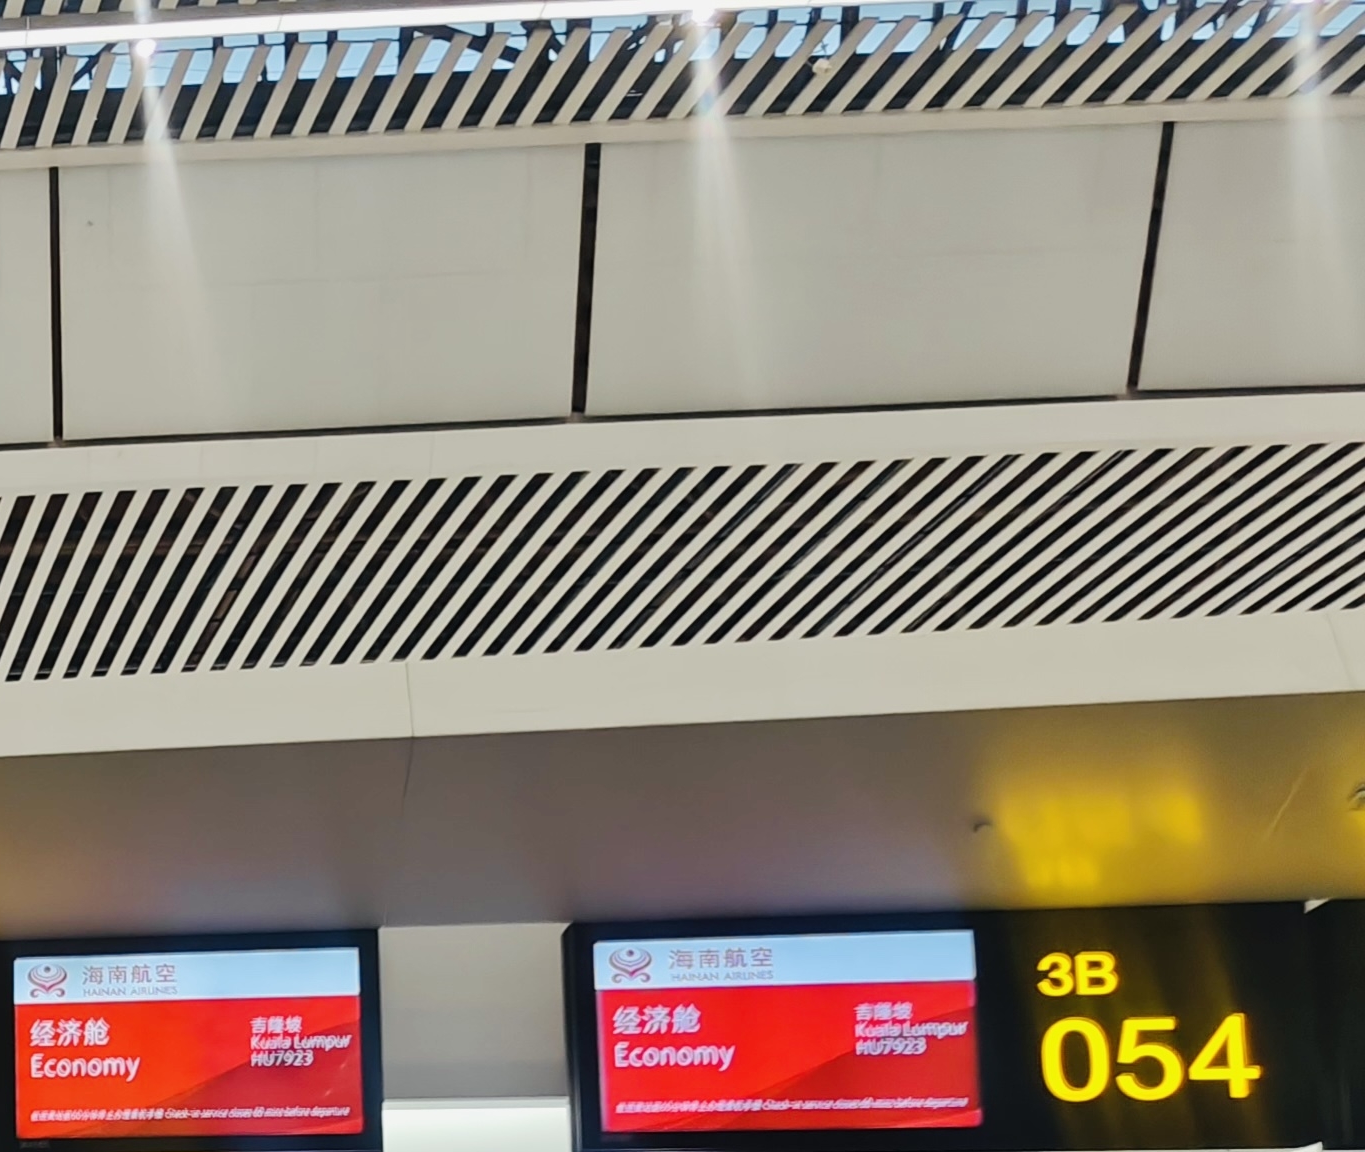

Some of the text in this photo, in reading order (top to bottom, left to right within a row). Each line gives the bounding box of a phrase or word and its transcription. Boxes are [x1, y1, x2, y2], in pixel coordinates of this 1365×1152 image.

[668, 947, 773, 969] 海南航空
[82, 963, 177, 984] 海南航空
[672, 972, 719, 982] HAINAN
[1037, 951, 1117, 996] 3B
[83, 987, 125, 997] HAINAN
[613, 1003, 701, 1034] 经济舱
[30, 1017, 109, 1047] 经济舱
[855, 1020, 968, 1039] Kuala Lumpur
[250, 1033, 352, 1051] Kuala Lumpur
[855, 1038, 926, 1056] HU7923
[30, 1053, 140, 1081] Economy
[250, 1050, 314, 1067] HU7923
[614, 1042, 735, 1071] Economy
[1040, 1013, 1260, 1103] 054
